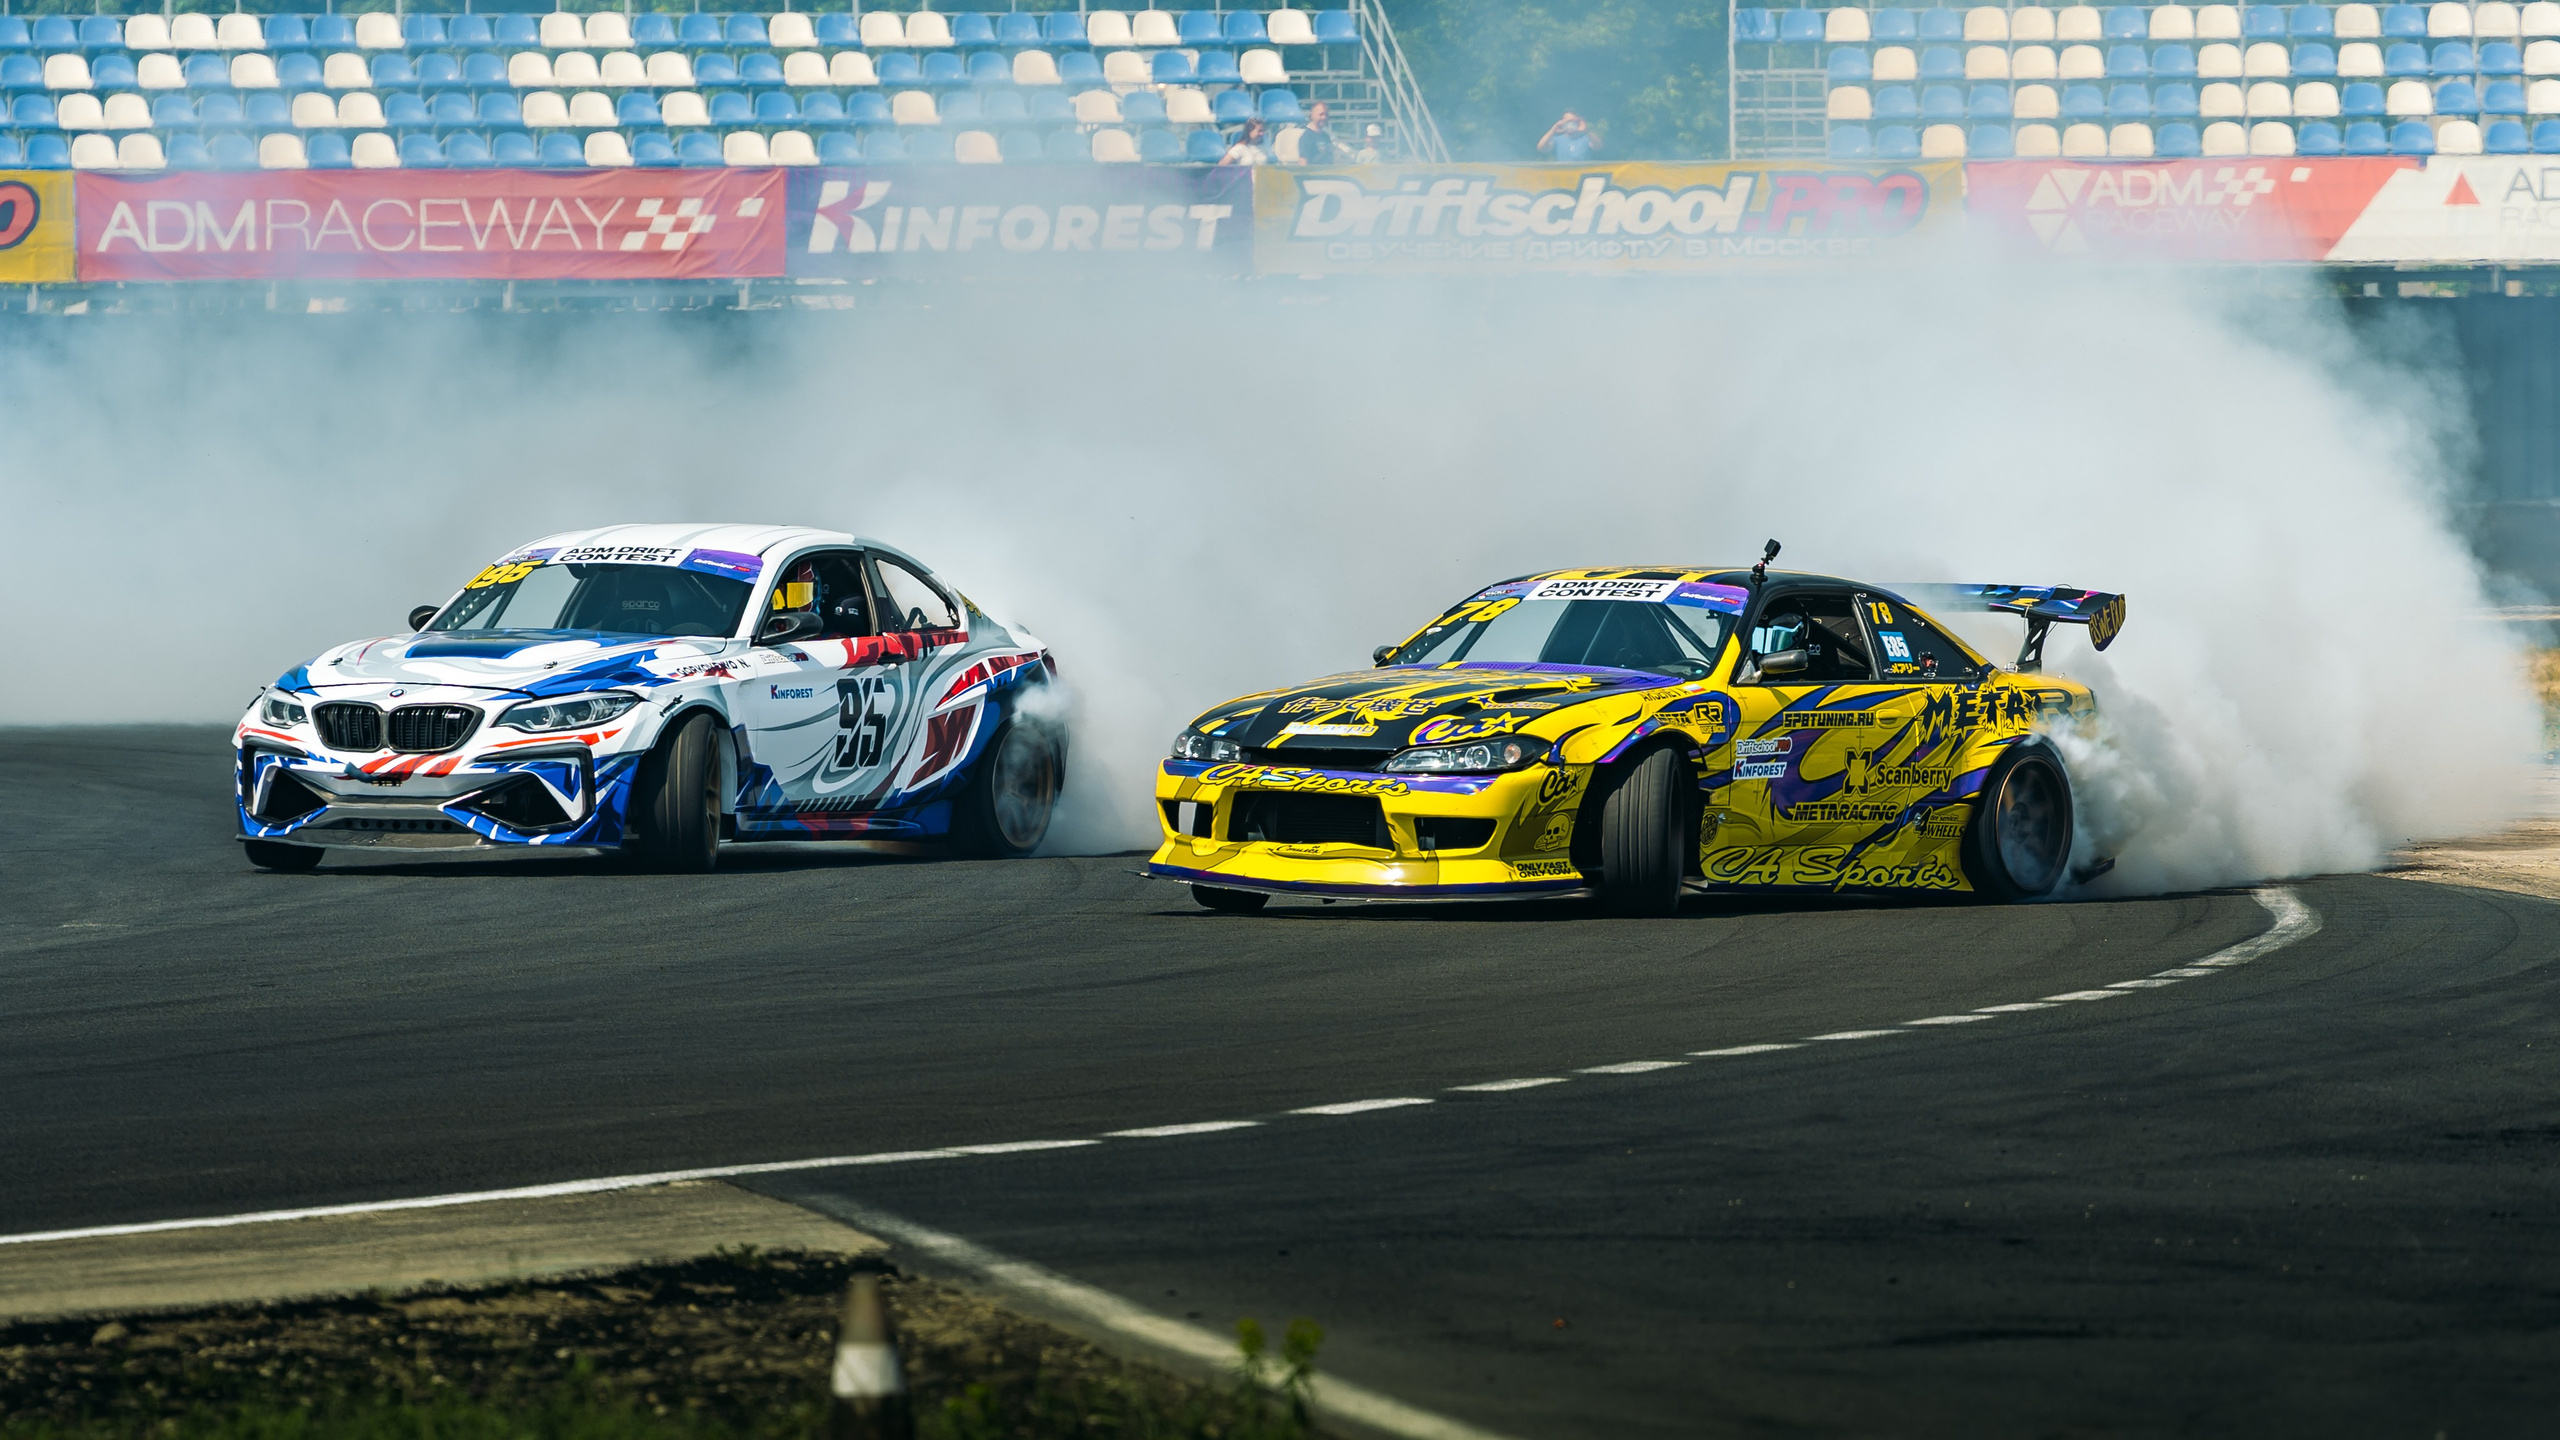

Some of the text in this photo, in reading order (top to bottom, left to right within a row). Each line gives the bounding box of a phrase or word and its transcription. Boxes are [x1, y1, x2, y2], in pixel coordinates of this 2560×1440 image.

[2086, 168, 2204, 207] ADM
[807, 180, 1233, 253] KINFOREST
[2084, 207, 2249, 233] RACEWAY
[1328, 241, 1511, 259] ОБУЧЕНИЕ
[1523, 239, 1671, 259] ДРИФТУ
[1684, 239, 1709, 257] В
[558, 553, 676, 563] CONTEST
[565, 546, 683, 556] ADM DRIFT
[1537, 588, 1662, 598] CONTEST
[1546, 581, 1669, 591] ADM DRIFT
[621, 599, 660, 611] sparco
[1437, 597, 1521, 626] 78
[1866, 602, 1893, 625] 78
[1881, 635, 1910, 658] E85
[770, 684, 813, 700] KINFOREST
[834, 677, 887, 768] 95
[1920, 689, 2028, 742] META
[1198, 762, 1411, 797] CA Sports
[1734, 760, 1786, 778] KINFOREST
[1876, 764, 1953, 791] Scanberry
[1516, 860, 1568, 872] ONLY FAST
[1519, 866, 1571, 879] ONLY LOW
[1700, 846, 1961, 893] CA Sports
